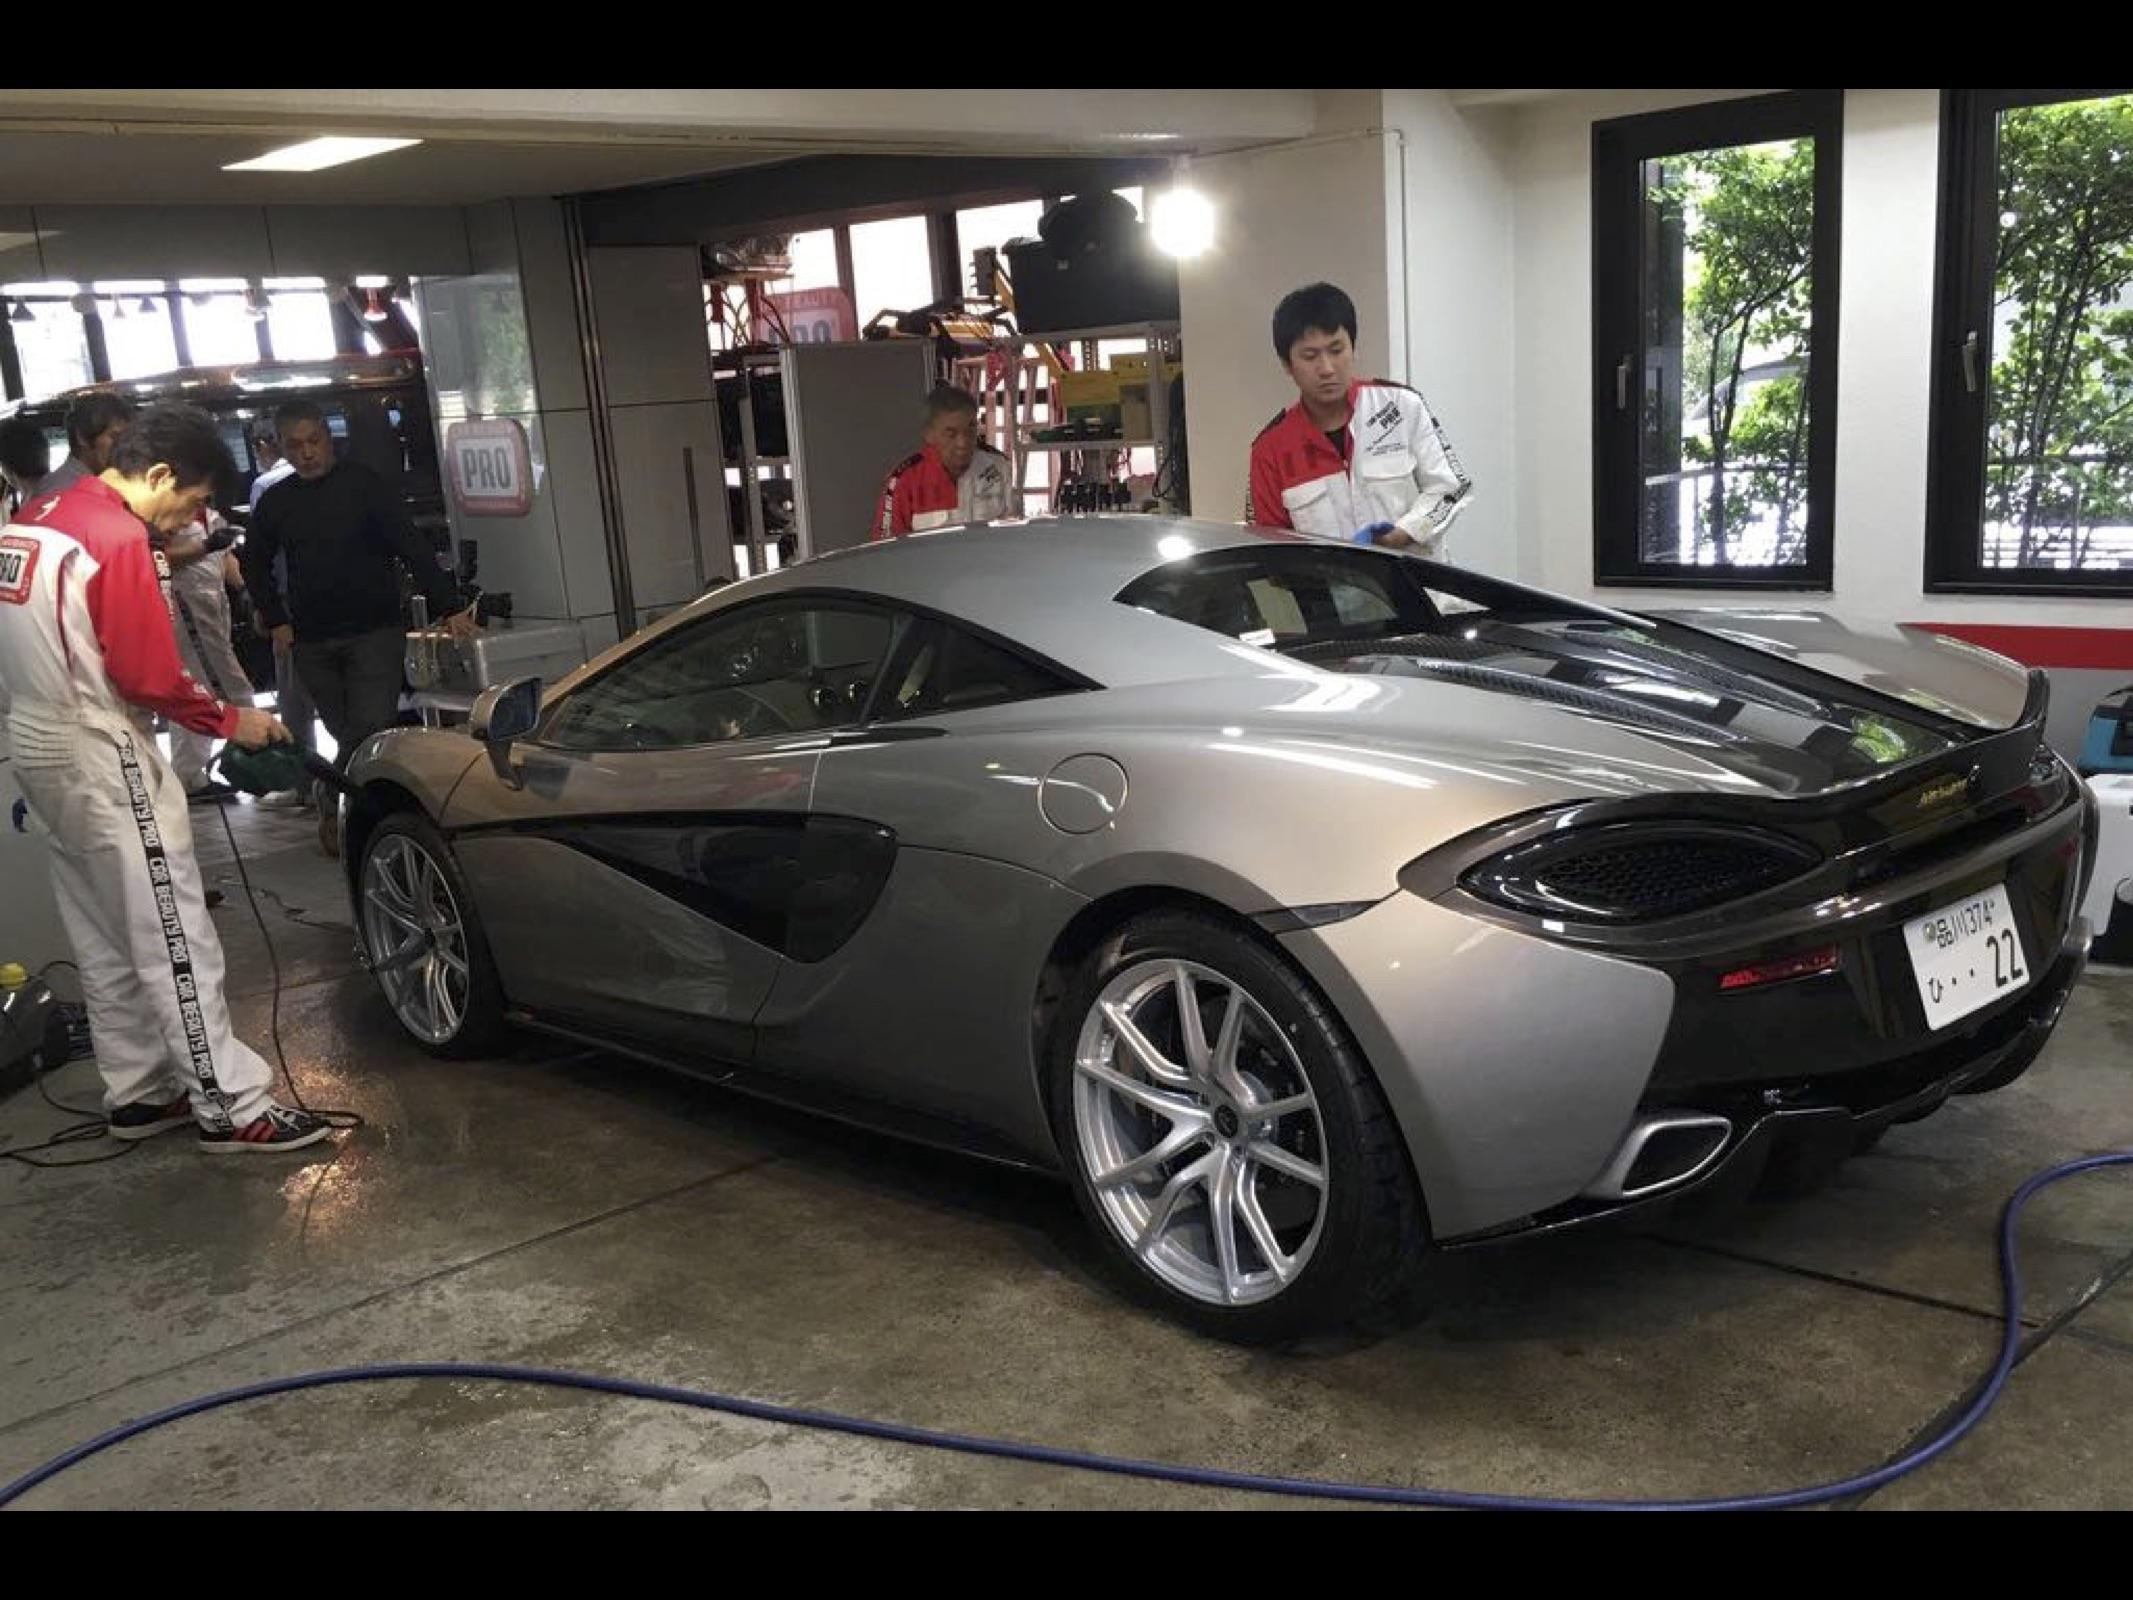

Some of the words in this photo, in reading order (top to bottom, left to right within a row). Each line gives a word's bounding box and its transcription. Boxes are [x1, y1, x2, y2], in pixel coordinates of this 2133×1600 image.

[461, 448, 512, 490] PRO
[138, 820, 159, 848] PRO
[149, 856, 169, 885] CAR
[155, 885, 182, 937] BEAUTY
[168, 936, 188, 963] PRO
[176, 973, 196, 1001] CAR
[181, 1001, 208, 1051] BEAUTY
[192, 1051, 214, 1079] PRO
